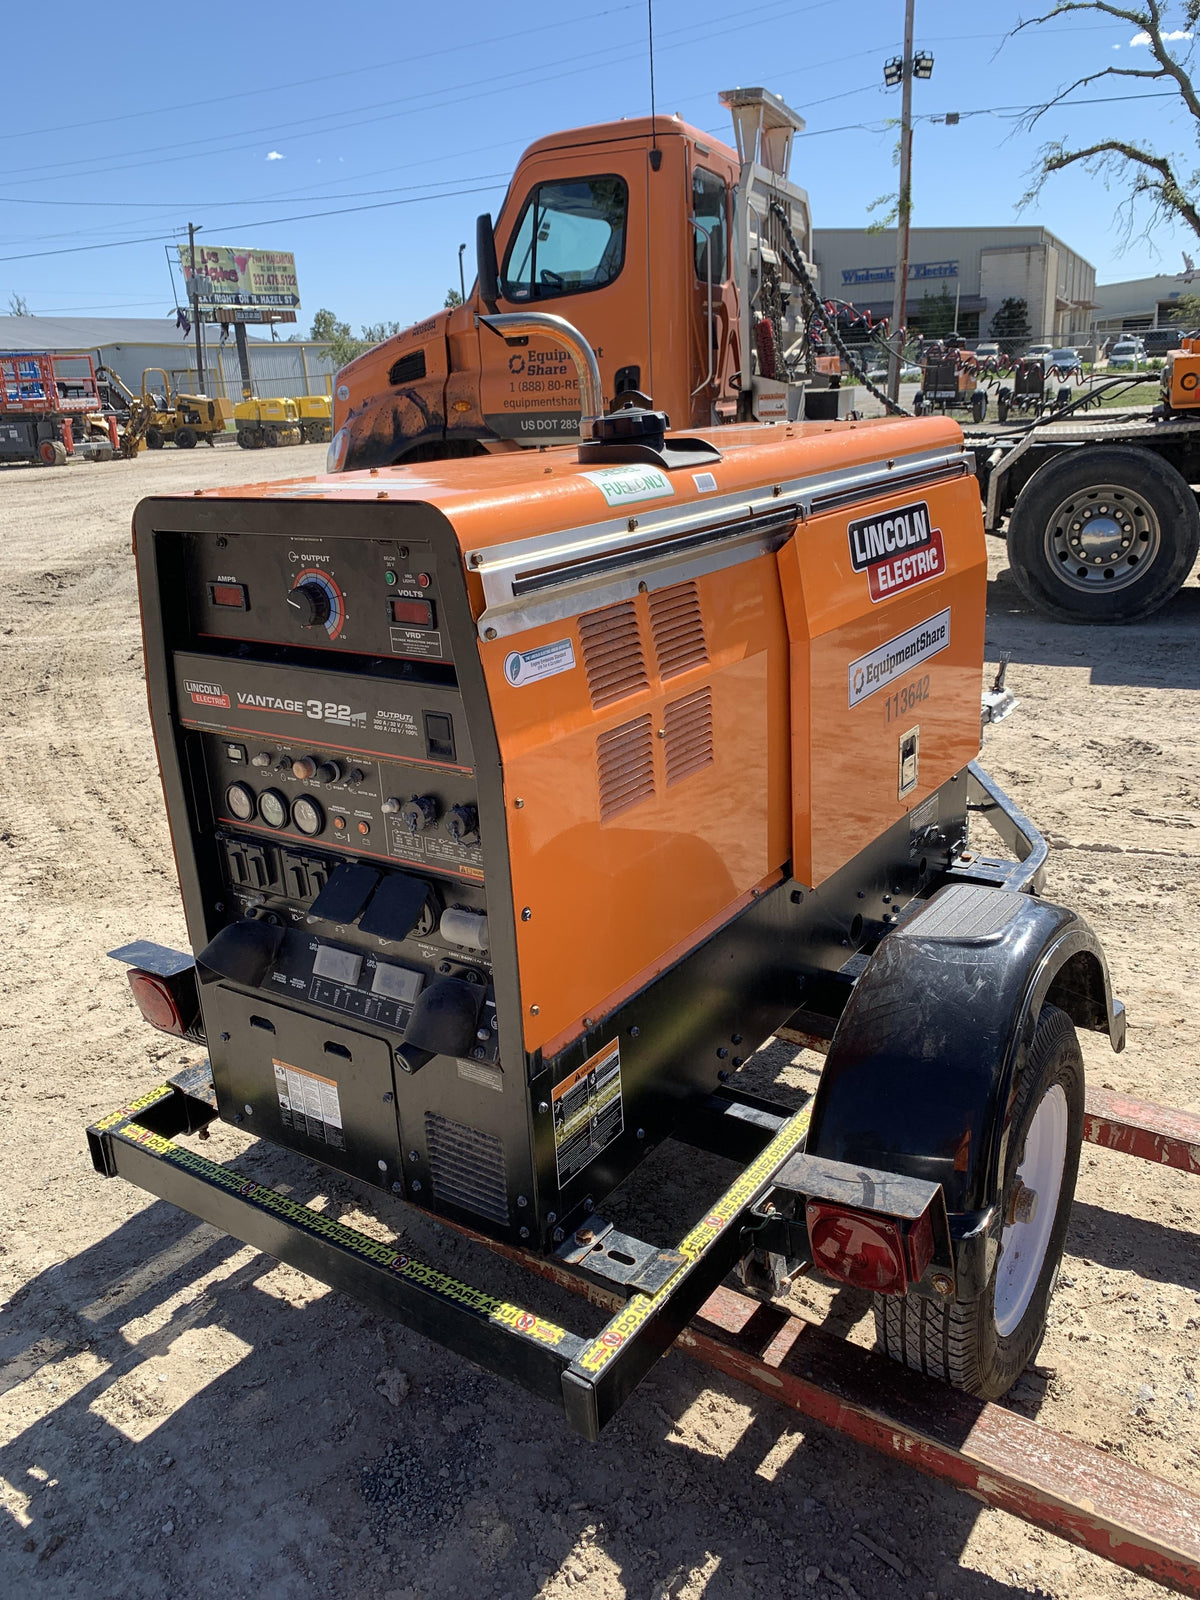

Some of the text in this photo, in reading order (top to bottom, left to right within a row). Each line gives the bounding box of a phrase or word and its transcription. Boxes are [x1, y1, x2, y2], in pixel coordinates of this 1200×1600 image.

[914, 263, 959, 278] Electric
[215, 292, 236, 304] RIGHT
[261, 295, 283, 304] HAZEL
[527, 364, 567, 376] Share
[510, 380, 579, 392] 1 (888) 80-RE
[520, 420, 535, 431] US
[537, 420, 558, 430] DOT
[853, 508, 928, 564] LINCOLN
[300, 554, 331, 563] OUTPUT
[878, 547, 939, 592] ELECTRIC
[217, 575, 237, 583] AMPS
[397, 589, 424, 598] VOLTS
[865, 624, 946, 685] EquipmentShare
[186, 681, 221, 695] LINCOLN
[195, 694, 227, 706] ELECTRIC
[236, 692, 351, 721] VANTAGE 322
[885, 674, 931, 723] 113642
[377, 710, 410, 721] OUTPUT
[151, 1138, 245, 1188] DO NOT STAND HERE
[718, 1114, 811, 1217] NE PAS TENEZ DEBOUT ICI
[253, 1189, 393, 1261] NE PAS TENEZ DEBOUT ICI
[685, 1226, 714, 1252] HERE
[406, 1264, 428, 1278] NO
[427, 1273, 447, 1288] SE
[444, 1283, 482, 1305] PARE
[616, 1313, 638, 1333] DO
